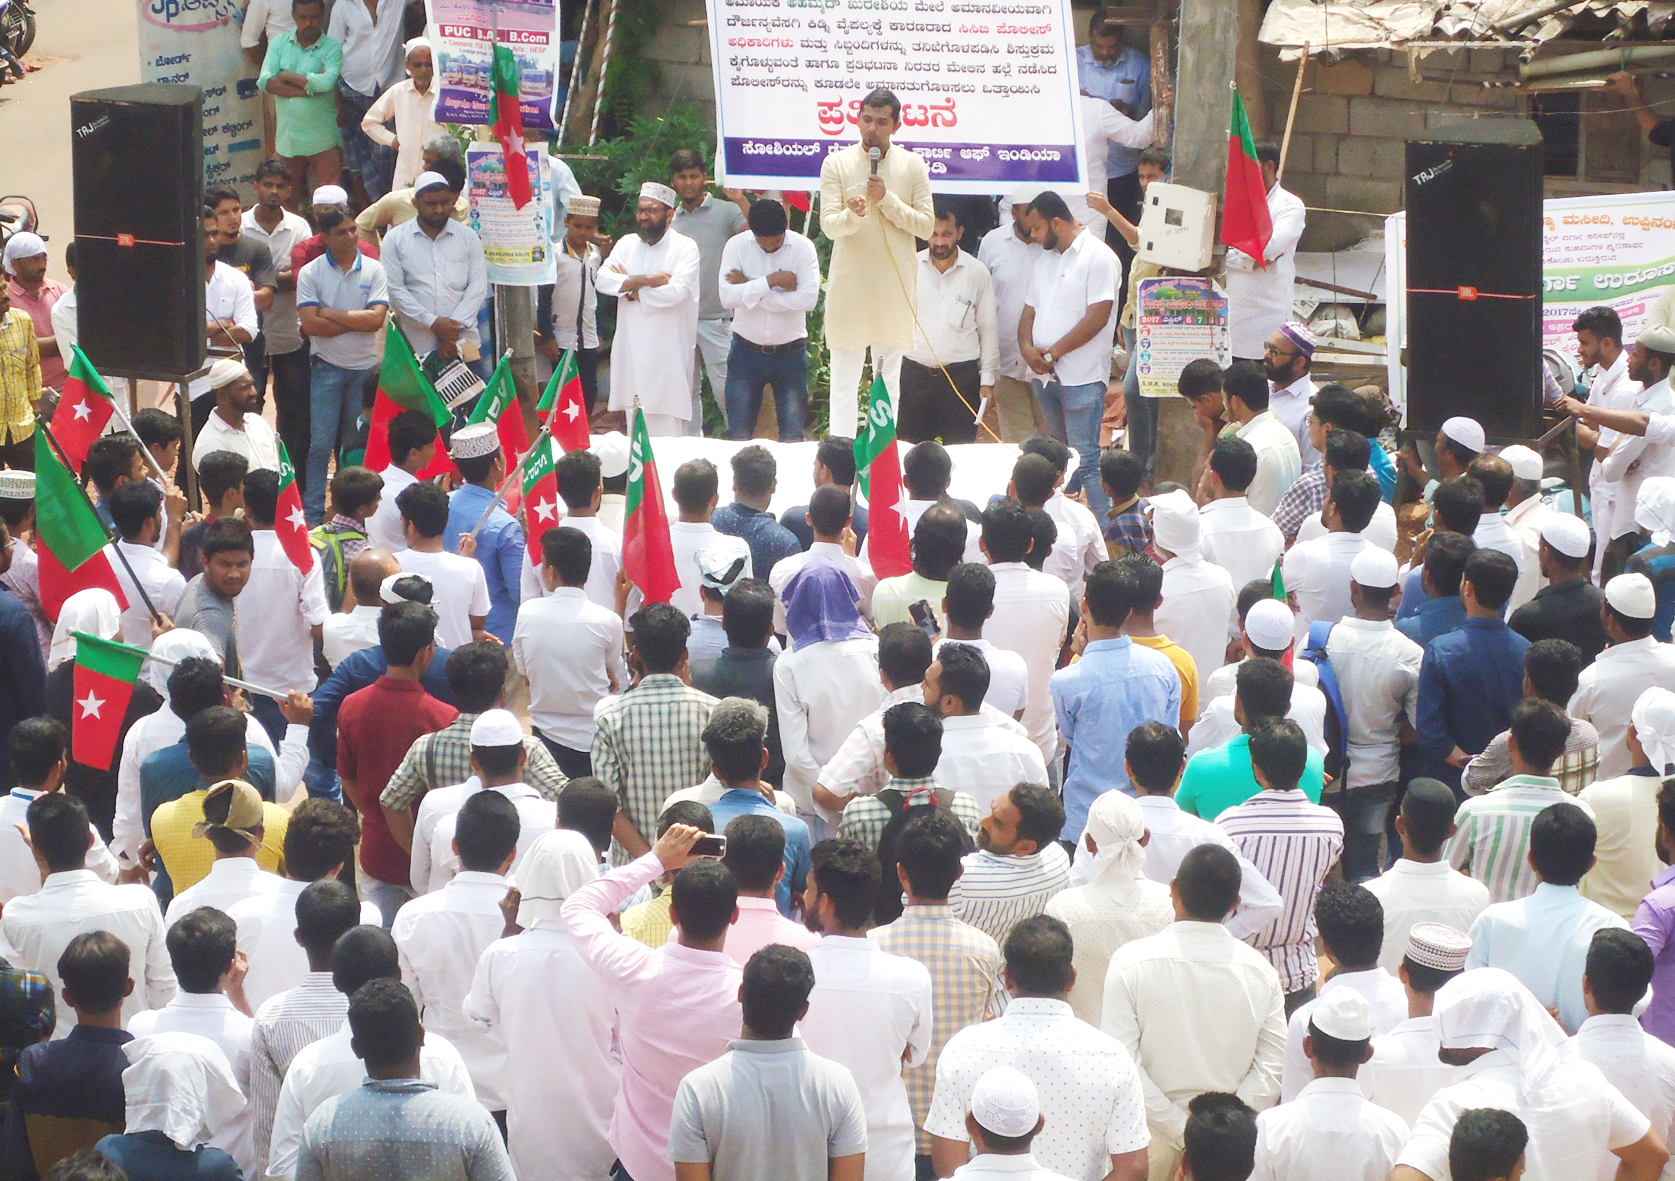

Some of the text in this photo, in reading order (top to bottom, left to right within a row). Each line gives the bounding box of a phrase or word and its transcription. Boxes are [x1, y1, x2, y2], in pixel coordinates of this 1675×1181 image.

[444, 25, 472, 37] PUC
[509, 31, 547, 43] B.Com
[889, 21, 951, 33] ಕಾರಣರಾದ
[959, 22, 990, 34] ಸಿಸಿಬಿ
[728, 36, 794, 48] ಅಧಿಕಾರಿಗಳು
[800, 38, 828, 53] ಮತ್ತು
[833, 40, 907, 56] ಸಿಬ್ಬಂದಿಗಳನ್ನು
[1006, 43, 1055, 58] ಶಿಸ್ತುಕ್ರಮ
[805, 58, 840, 69] ಹಾಗೂ
[846, 59, 899, 73] ಪ್ರತಿಭಟನಾ
[904, 61, 941, 73] ನಿರತರ
[946, 61, 986, 74] ಮೇಲಿನ
[992, 63, 1012, 77] ಹಲ್ಲೆ
[1018, 63, 1058, 75] ನಡೆಸಿದ
[814, 77, 861, 90] ಕೂಡಲೇ
[982, 82, 1041, 98] ಒತ್ತಾಯಿಸಿ
[76, 122, 94, 138] TAJ
[959, 146, 990, 161] ಆಫ್
[997, 147, 1061, 161] ಇಂಡಿಯಾ
[1412, 167, 1435, 185] TAJ
[1197, 316, 1203, 324] 7
